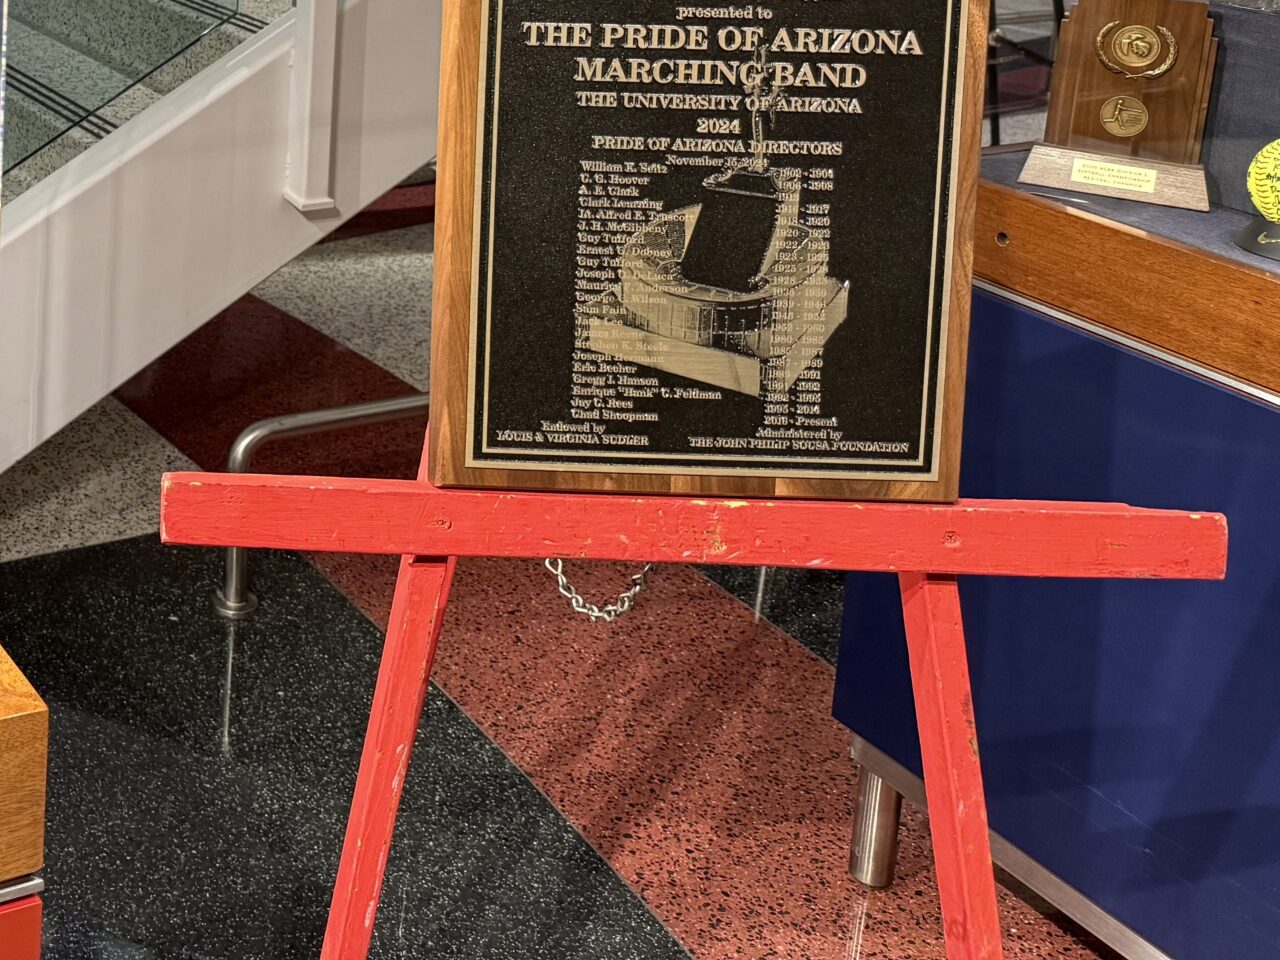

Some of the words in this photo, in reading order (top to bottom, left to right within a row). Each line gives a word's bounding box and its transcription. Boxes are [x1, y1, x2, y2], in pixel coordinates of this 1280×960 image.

[676, 6, 753, 20] presented
[756, 6, 773, 19] to
[522, 21, 592, 47] THE
[600, 23, 708, 51] PRIDE
[718, 25, 764, 52] OF
[771, 27, 923, 55] ARIZONA
[574, 57, 763, 86] MARCHING
[771, 62, 867, 88] BAND
[577, 91, 618, 108] THE
[621, 93, 742, 111] UNIVERSITY
[745, 95, 771, 112] OF
[776, 96, 862, 114] ARIZONA
[697, 117, 741, 134] 2024
[592, 136, 644, 151] PRIDE
[648, 137, 670, 151] OF
[671, 138, 746, 152] ARIZONA
[748, 140, 843, 156] DIRECTORS
[665, 154, 722, 167] November
[572, 374, 605, 386] Gregg
[606, 375, 615, 385] J.
[617, 375, 659, 386] Hanson
[541, 420, 590, 432] Endowed
[592, 422, 606, 434] by
[756, 426, 827, 439] Administered
[828, 429, 843, 441] by
[496, 430, 533, 442] LOUIS
[534, 432, 544, 442] &
[547, 433, 600, 445] VIRGINIA
[602, 434, 650, 446] SUDLER
[688, 436, 714, 447] THE
[714, 437, 748, 449] JOHN
[749, 438, 790, 450] PHILIP
[792, 439, 830, 451] SOUSA
[831, 440, 910, 453] FOUNDATION
